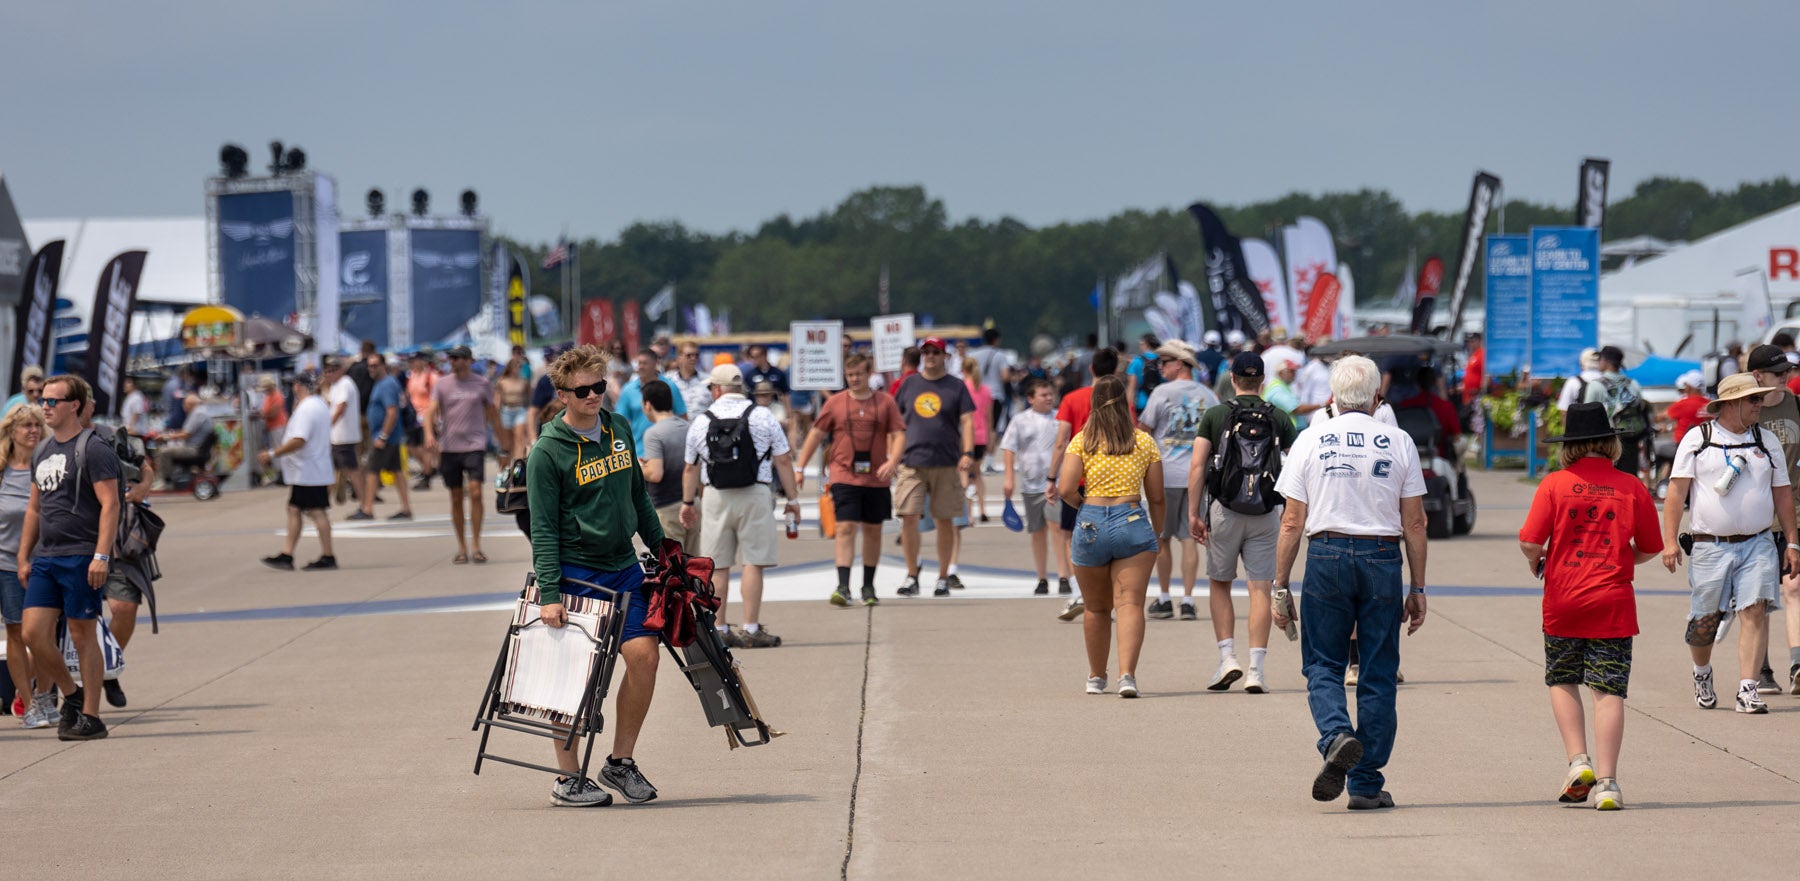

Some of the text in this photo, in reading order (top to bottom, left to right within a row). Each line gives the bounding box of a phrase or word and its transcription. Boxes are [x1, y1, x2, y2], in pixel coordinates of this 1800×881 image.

[22, 253, 53, 368] OSE
[98, 259, 132, 417] BOSE
[807, 330, 827, 344] NO
[580, 452, 631, 482] PACKERS
